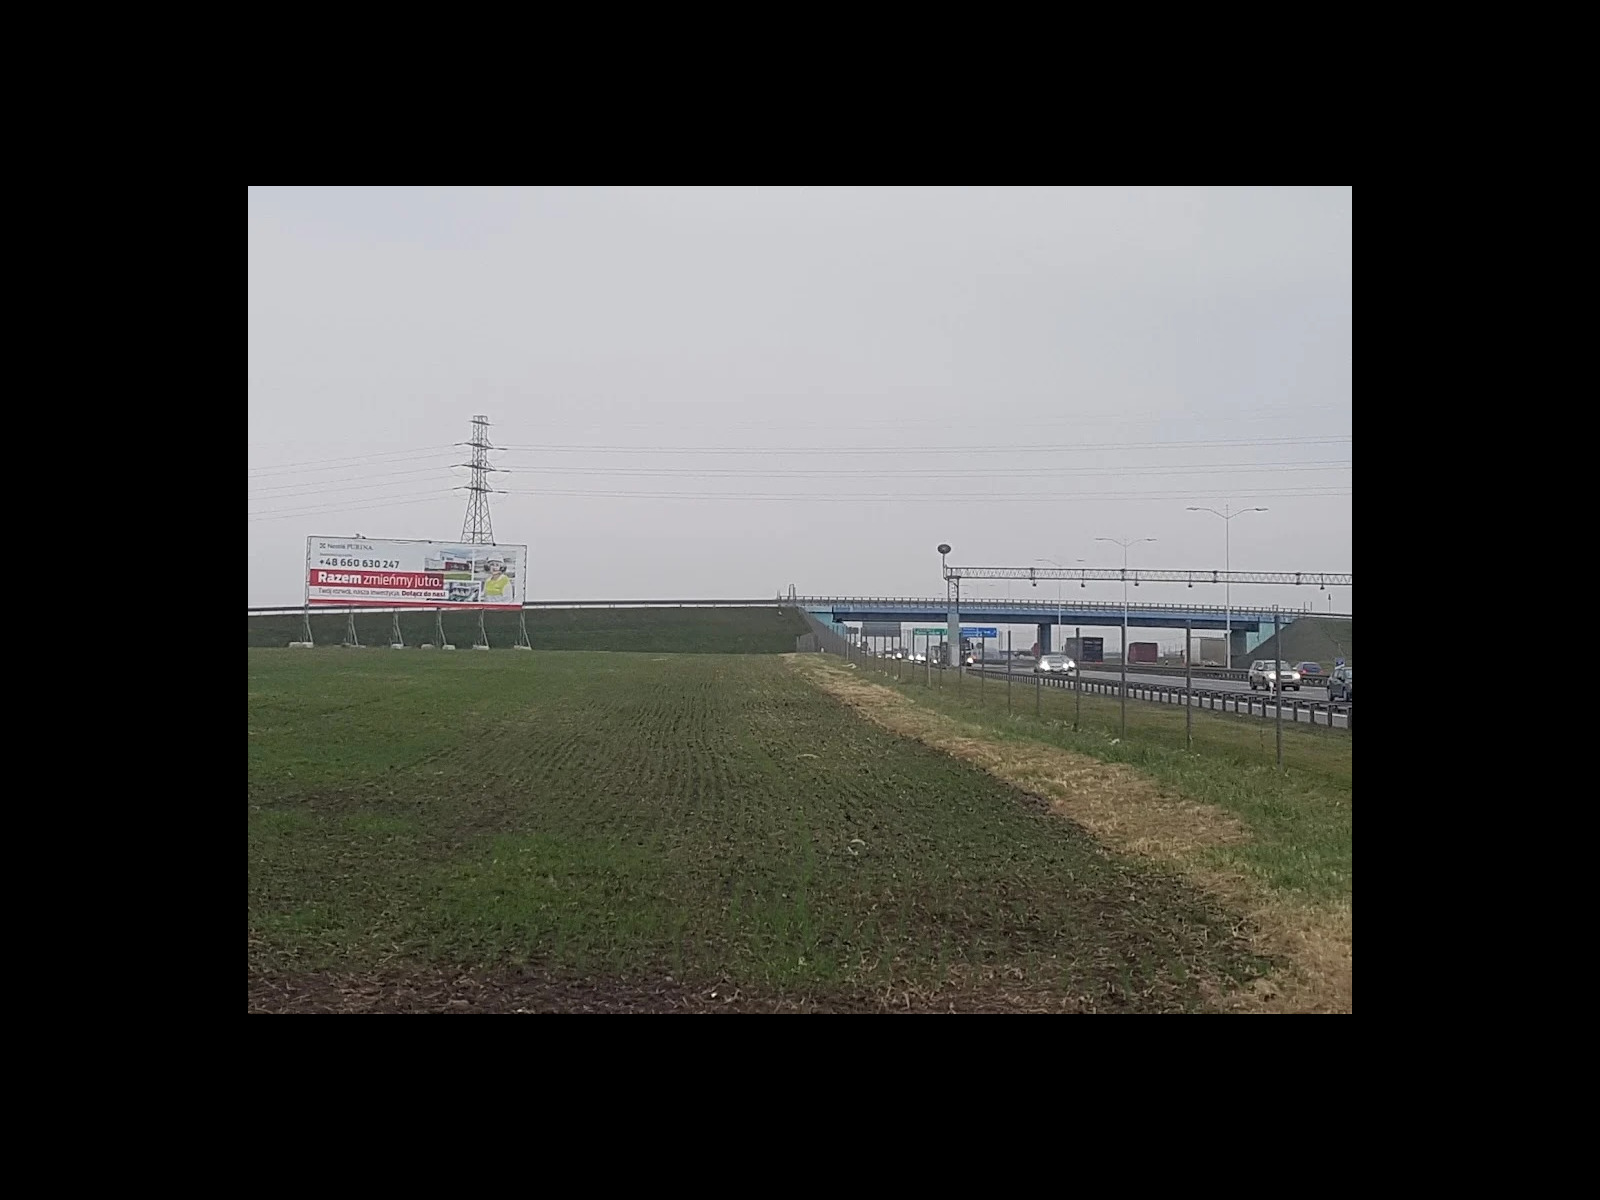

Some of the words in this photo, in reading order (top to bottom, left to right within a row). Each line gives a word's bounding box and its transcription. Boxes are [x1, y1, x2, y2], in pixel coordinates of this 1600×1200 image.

[320, 558, 338, 566] +48
[340, 558, 360, 567] 660
[362, 560, 380, 568] 630
[383, 560, 400, 569] 247
[318, 571, 362, 584] Razem
[363, 573, 413, 588] zmieńmy
[414, 575, 442, 588] jutro.
